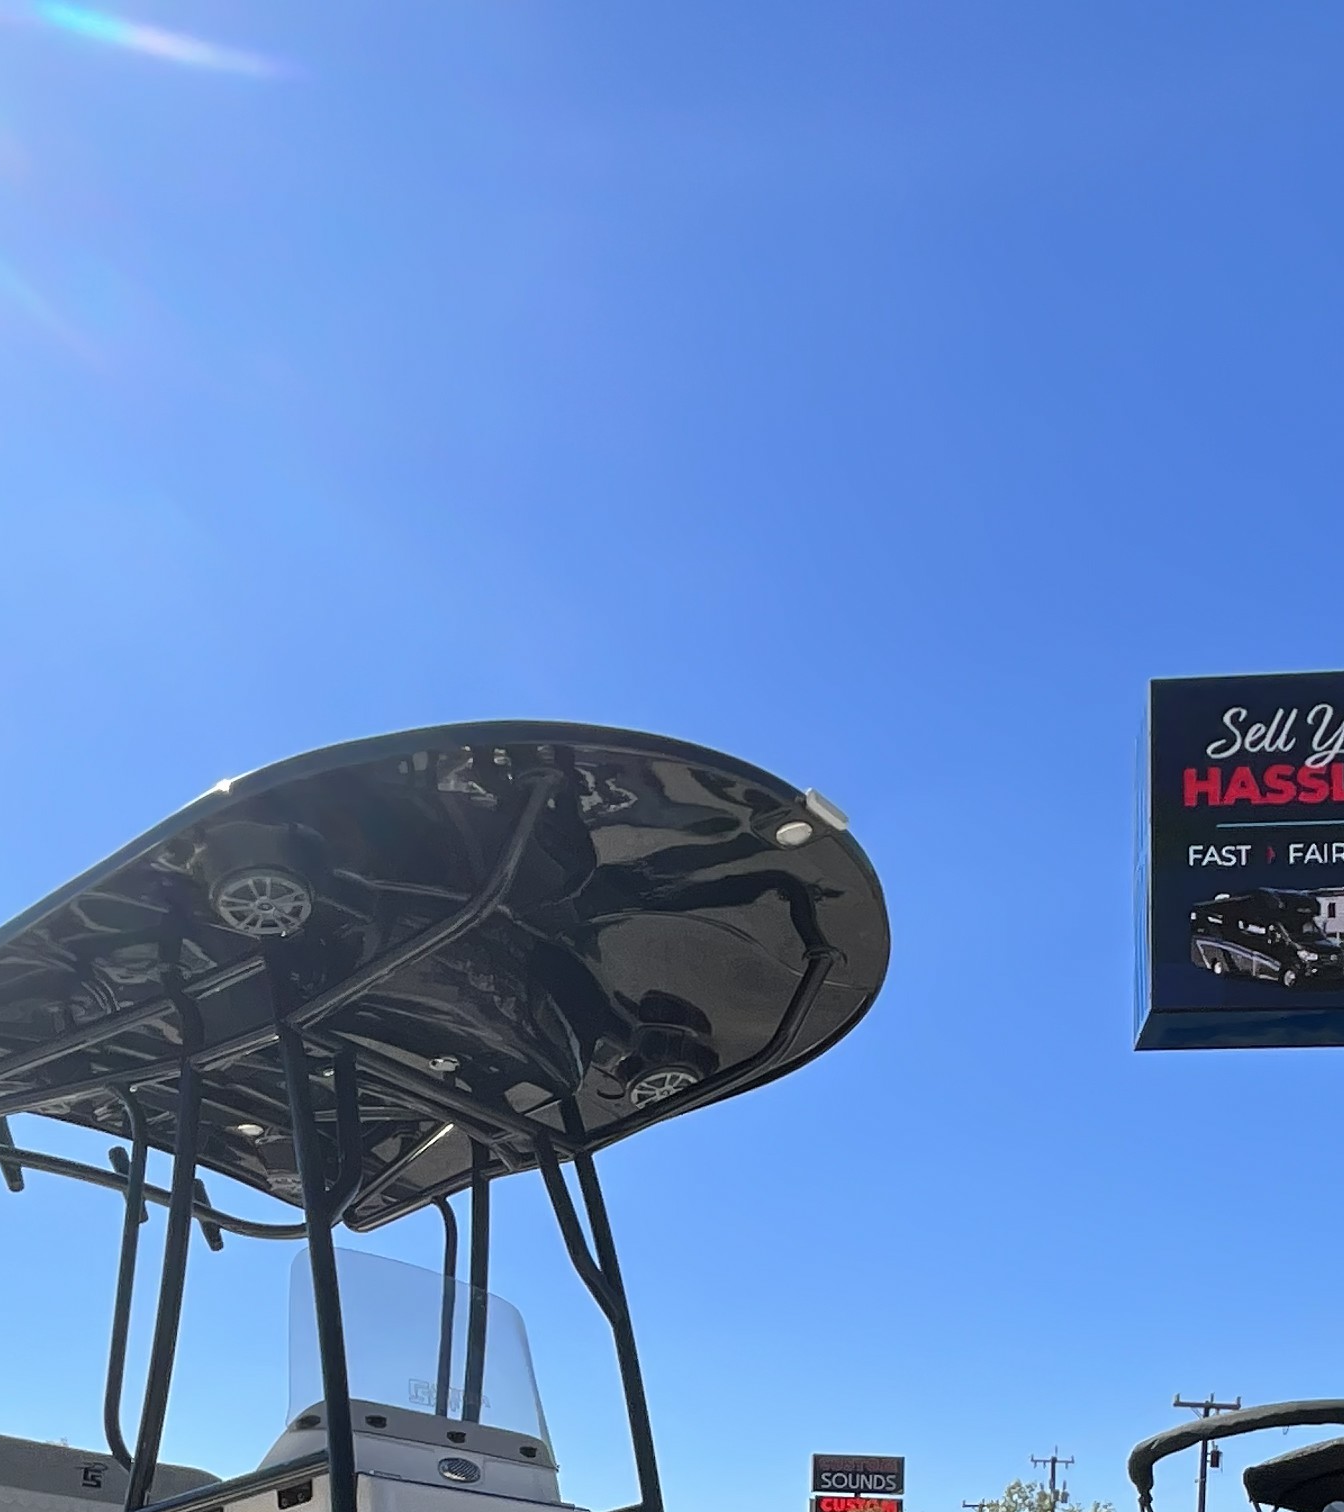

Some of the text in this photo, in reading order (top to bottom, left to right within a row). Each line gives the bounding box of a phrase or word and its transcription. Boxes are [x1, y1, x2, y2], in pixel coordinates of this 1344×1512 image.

[1206, 707, 1298, 759] Sell
[1188, 845, 1251, 867] FAST
[821, 1472, 896, 1491] SOUNDS
